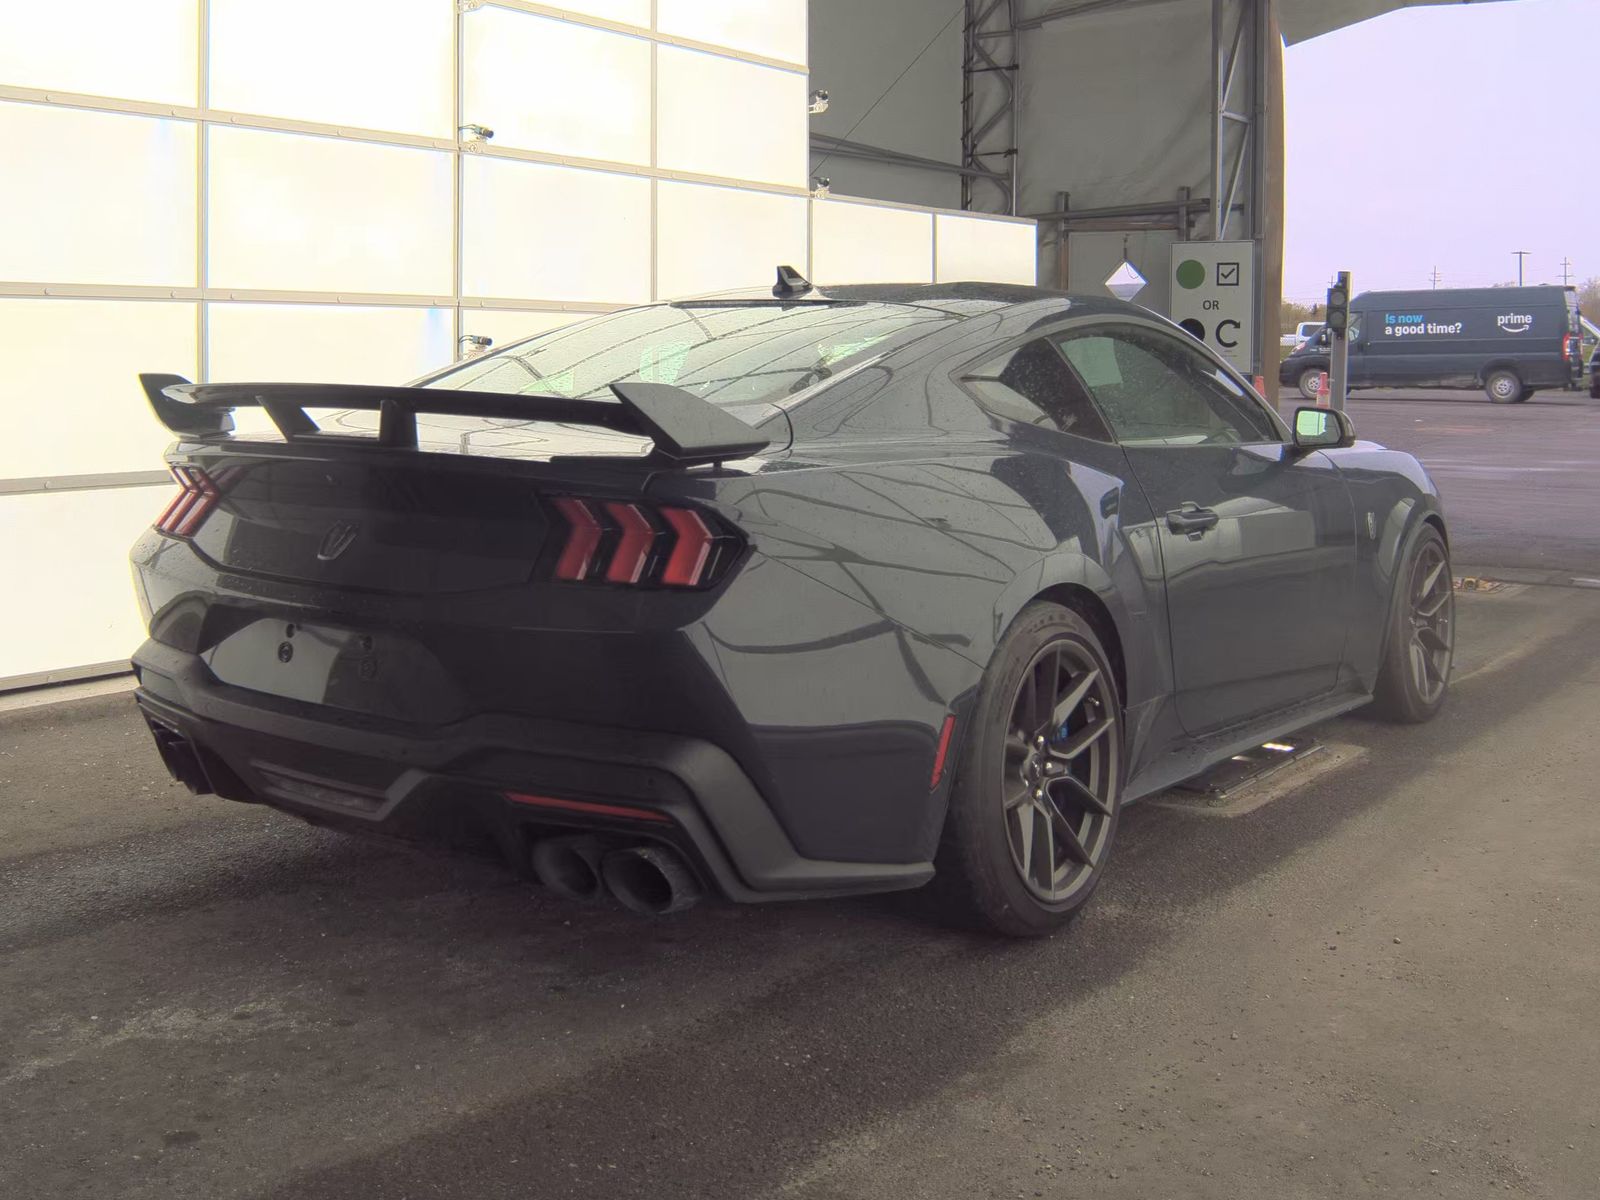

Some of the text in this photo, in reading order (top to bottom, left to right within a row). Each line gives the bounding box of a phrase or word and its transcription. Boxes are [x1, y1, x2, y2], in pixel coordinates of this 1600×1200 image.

[1202, 299, 1220, 310] OR
[1385, 314, 1423, 324] Is now
[1497, 313, 1533, 326] prime
[1385, 322, 1463, 337] a good time?
